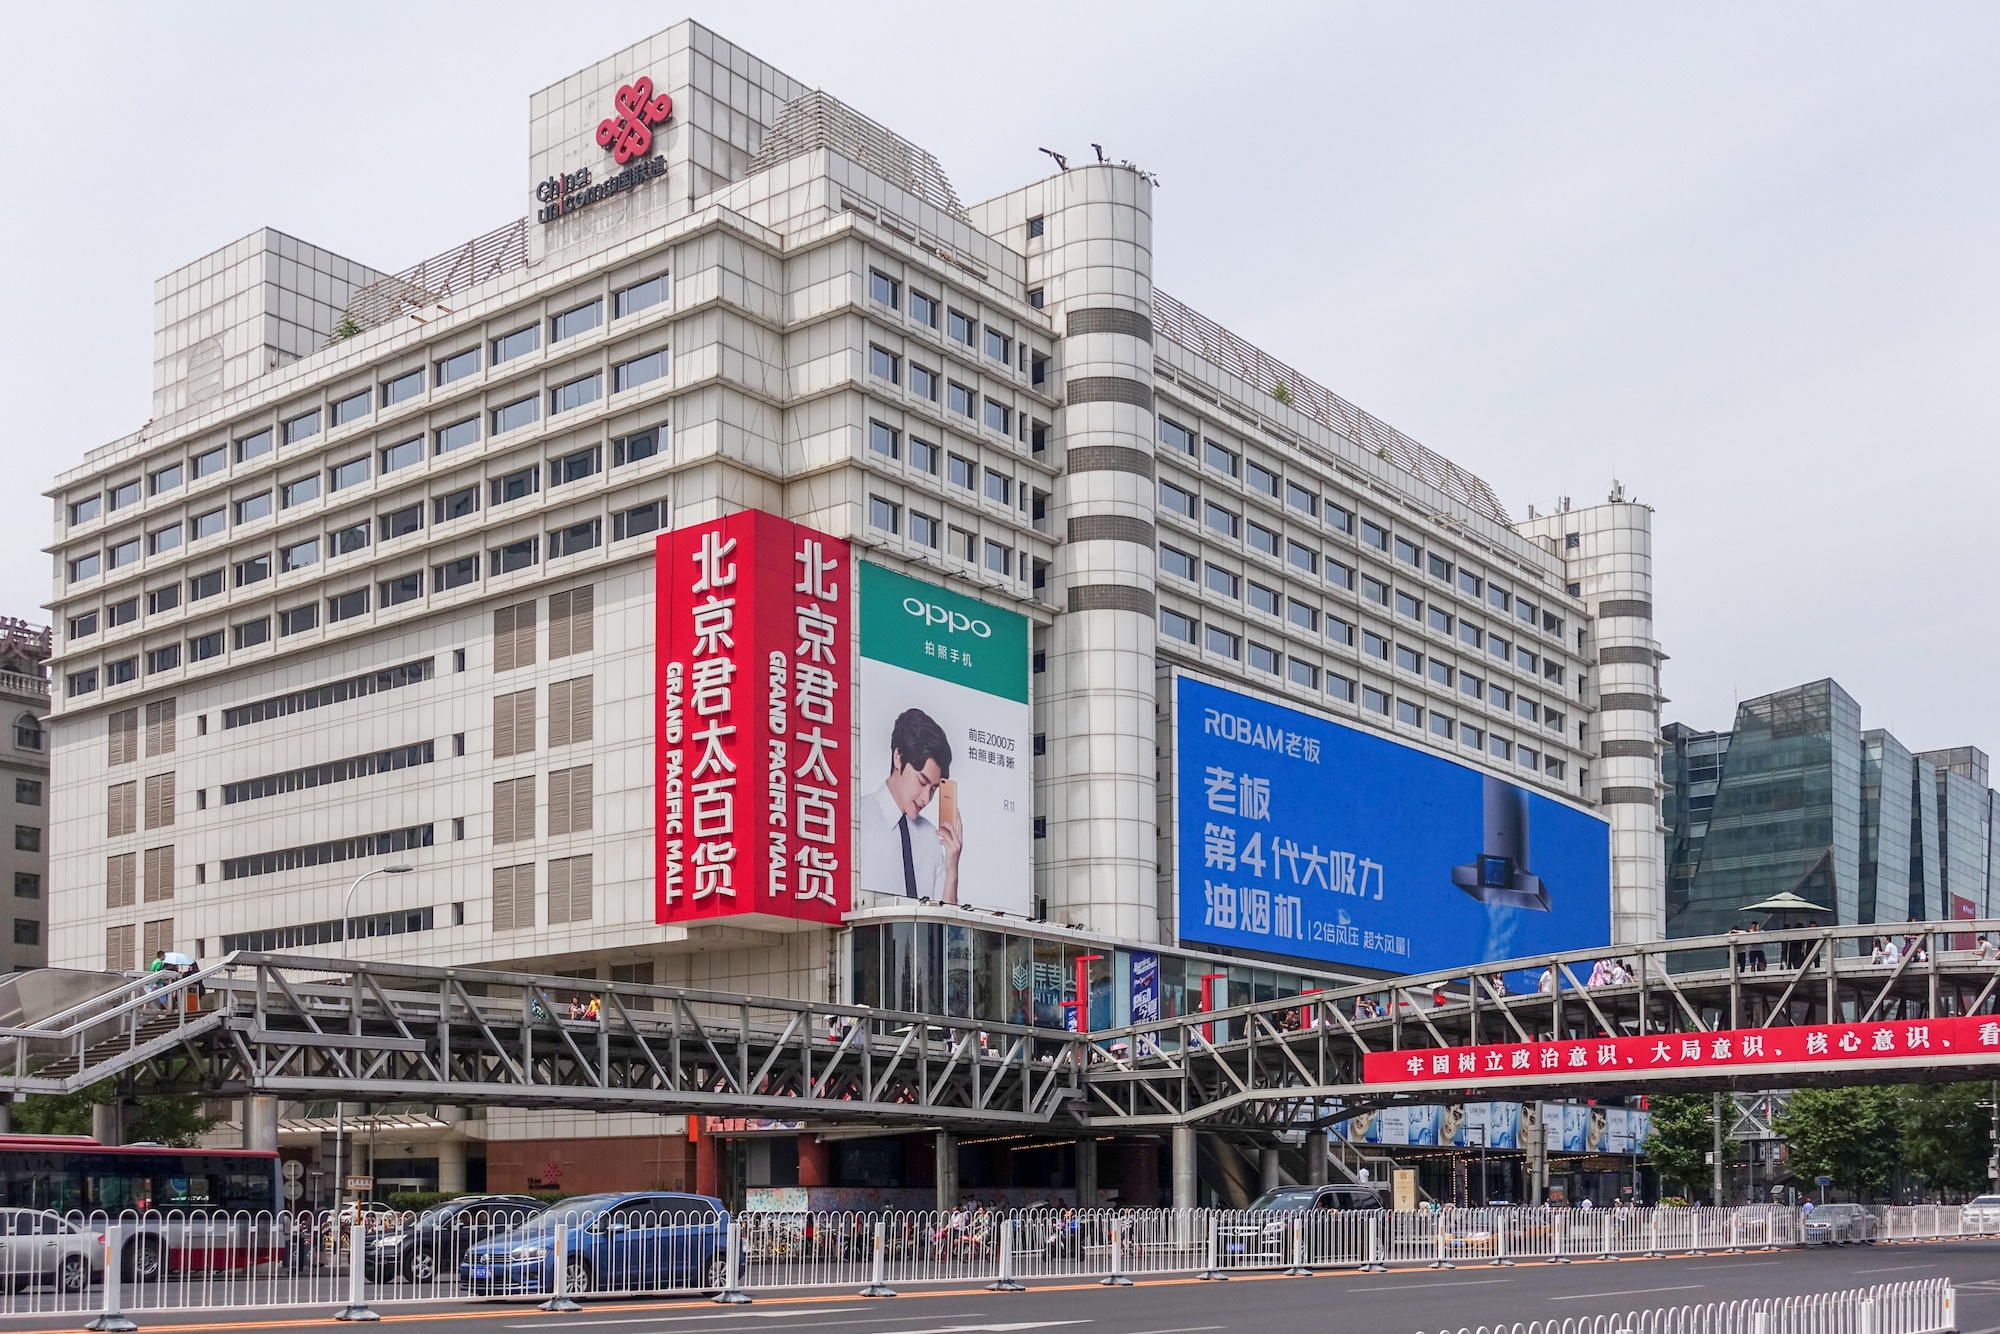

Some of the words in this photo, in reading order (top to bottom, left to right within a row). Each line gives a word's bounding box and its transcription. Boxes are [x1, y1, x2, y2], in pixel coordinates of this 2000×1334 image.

[536, 167, 588, 202] China
[924, 640, 973, 668] 拍照手机
[666, 662, 684, 744] GRAND
[691, 530, 737, 900] 北京君太百货
[769, 650, 787, 735] GRAND
[794, 538, 839, 907] 北京君太百货
[968, 727, 1015, 752] 前后2000万
[968, 745, 1015, 770] 拍照更清晰
[1285, 732, 1321, 765] 老板
[666, 750, 684, 836] PACIFIC
[769, 739, 787, 827] PACIFIC
[1003, 799, 1015, 813] R11
[1204, 766, 1271, 823] 老板
[666, 838, 684, 905] MALL
[769, 831, 787, 898] MALL
[1204, 822, 1384, 901] 第4代大吸力
[1204, 880, 1303, 941] 油烟机
[1034, 992, 1059, 1005] WITH
